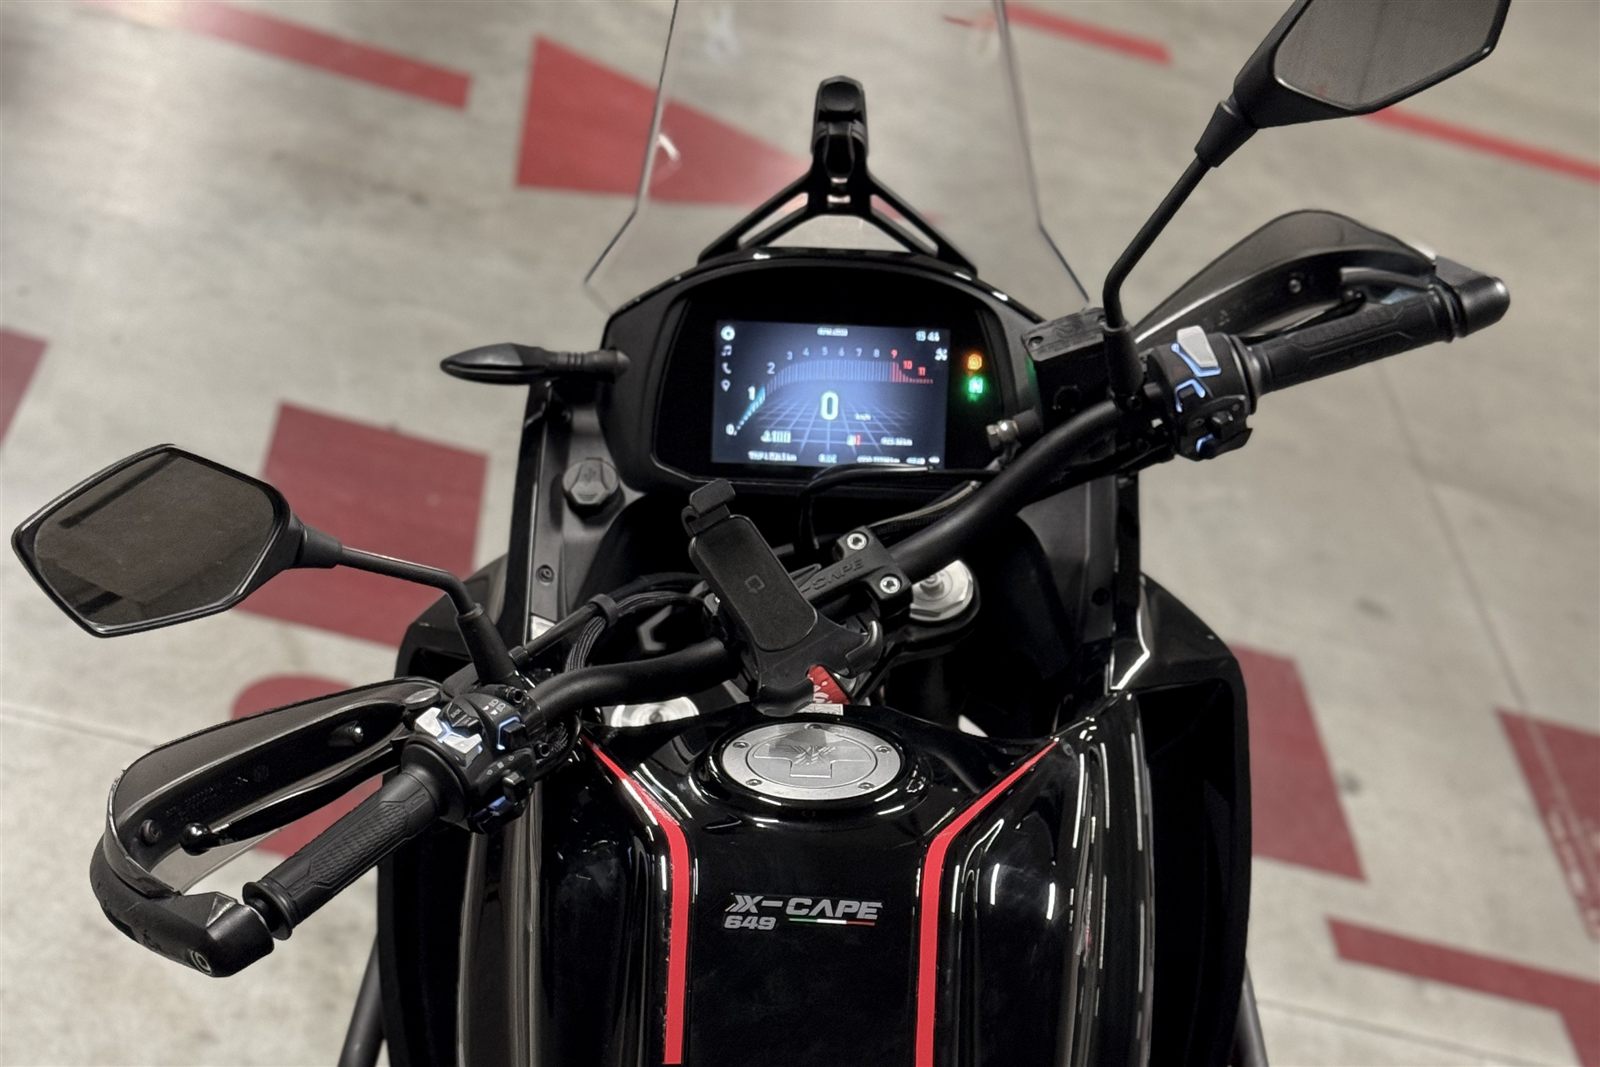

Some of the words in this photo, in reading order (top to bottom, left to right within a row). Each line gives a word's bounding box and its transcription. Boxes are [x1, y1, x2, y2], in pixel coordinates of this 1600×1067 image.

[748, 385, 755, 401] 1
[767, 362, 775, 374] 2
[786, 351, 793, 360] 3
[803, 347, 810, 356] 4
[822, 346, 828, 355] 5
[839, 347, 845, 356] 6
[856, 347, 862, 356] 7
[873, 348, 880, 358] 8
[891, 349, 898, 358] 9
[903, 360, 912, 369] 10
[918, 367, 926, 376] 11
[820, 390, 839, 421] 0
[726, 894, 883, 920] X-CAPE
[724, 915, 776, 930] 649
